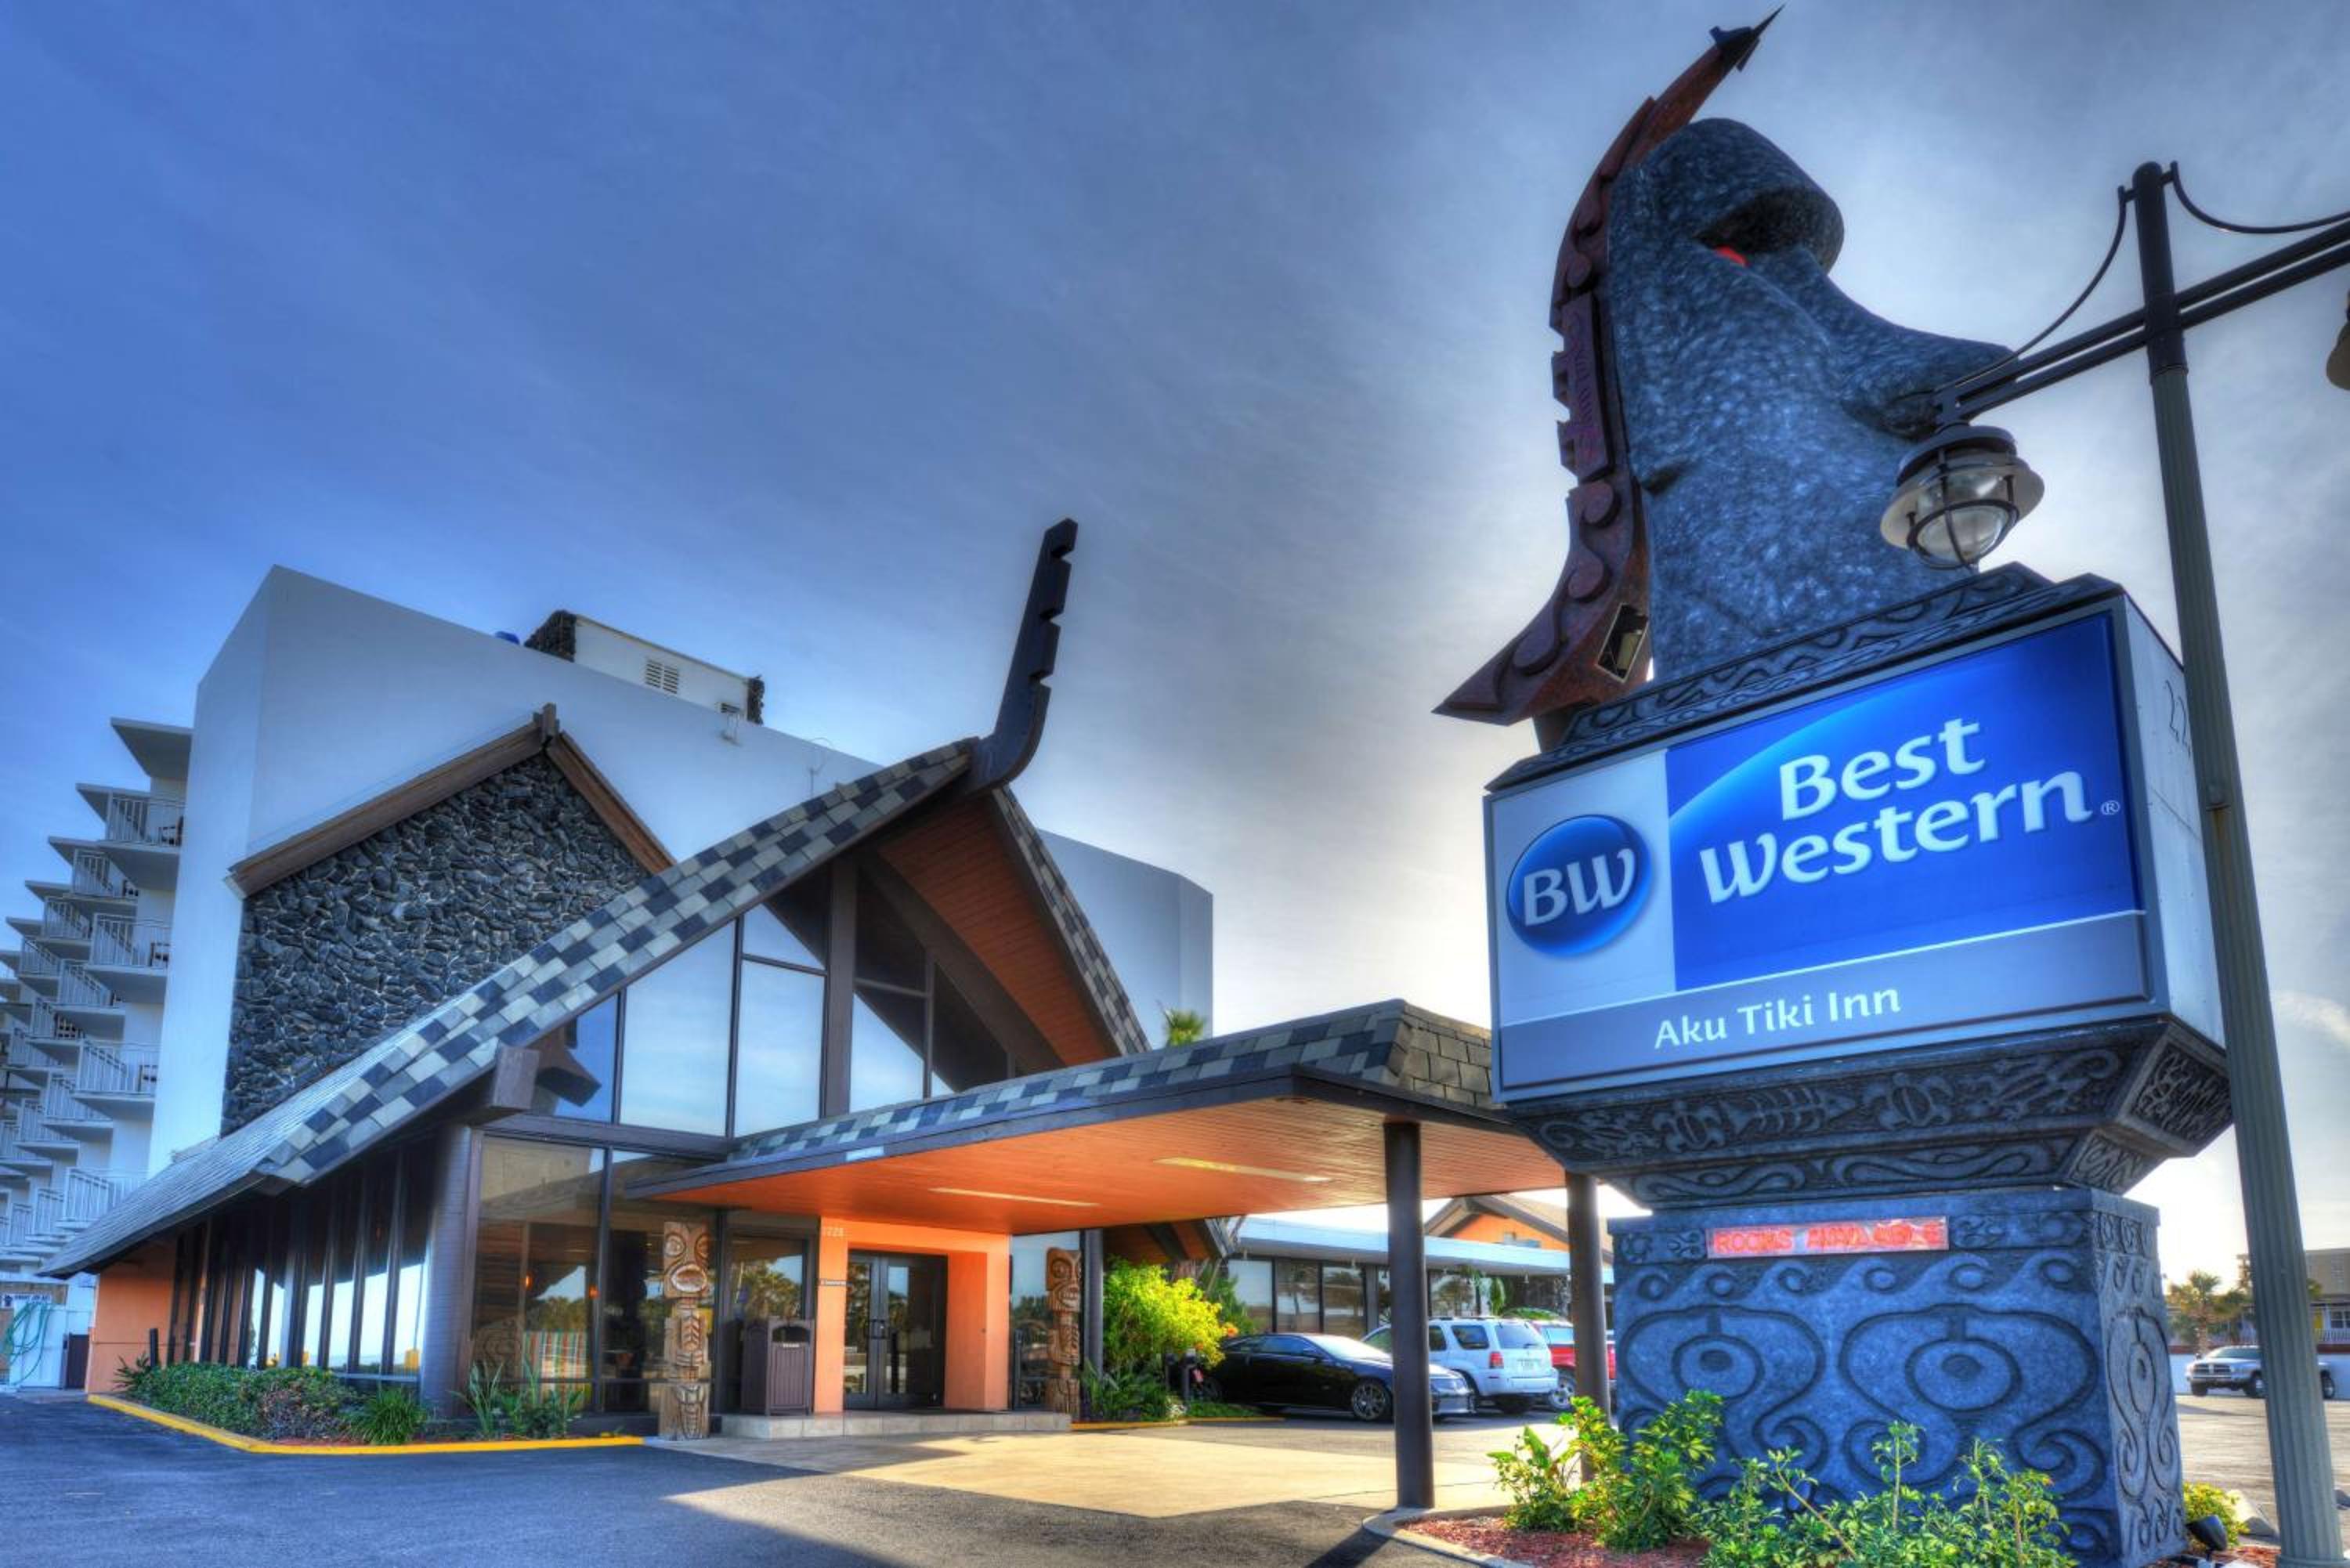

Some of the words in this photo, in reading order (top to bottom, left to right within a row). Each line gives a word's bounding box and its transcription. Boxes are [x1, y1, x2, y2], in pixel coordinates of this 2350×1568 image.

[1779, 718, 1985, 821] Best
[1699, 771, 2093, 904] Western
[1524, 848, 1636, 927] BW
[1654, 1015, 1727, 1050] Aku
[1737, 995, 1814, 1035] Tiki
[1828, 988, 1901, 1022] Inn
[1713, 1227, 1794, 1252] ROOMS
